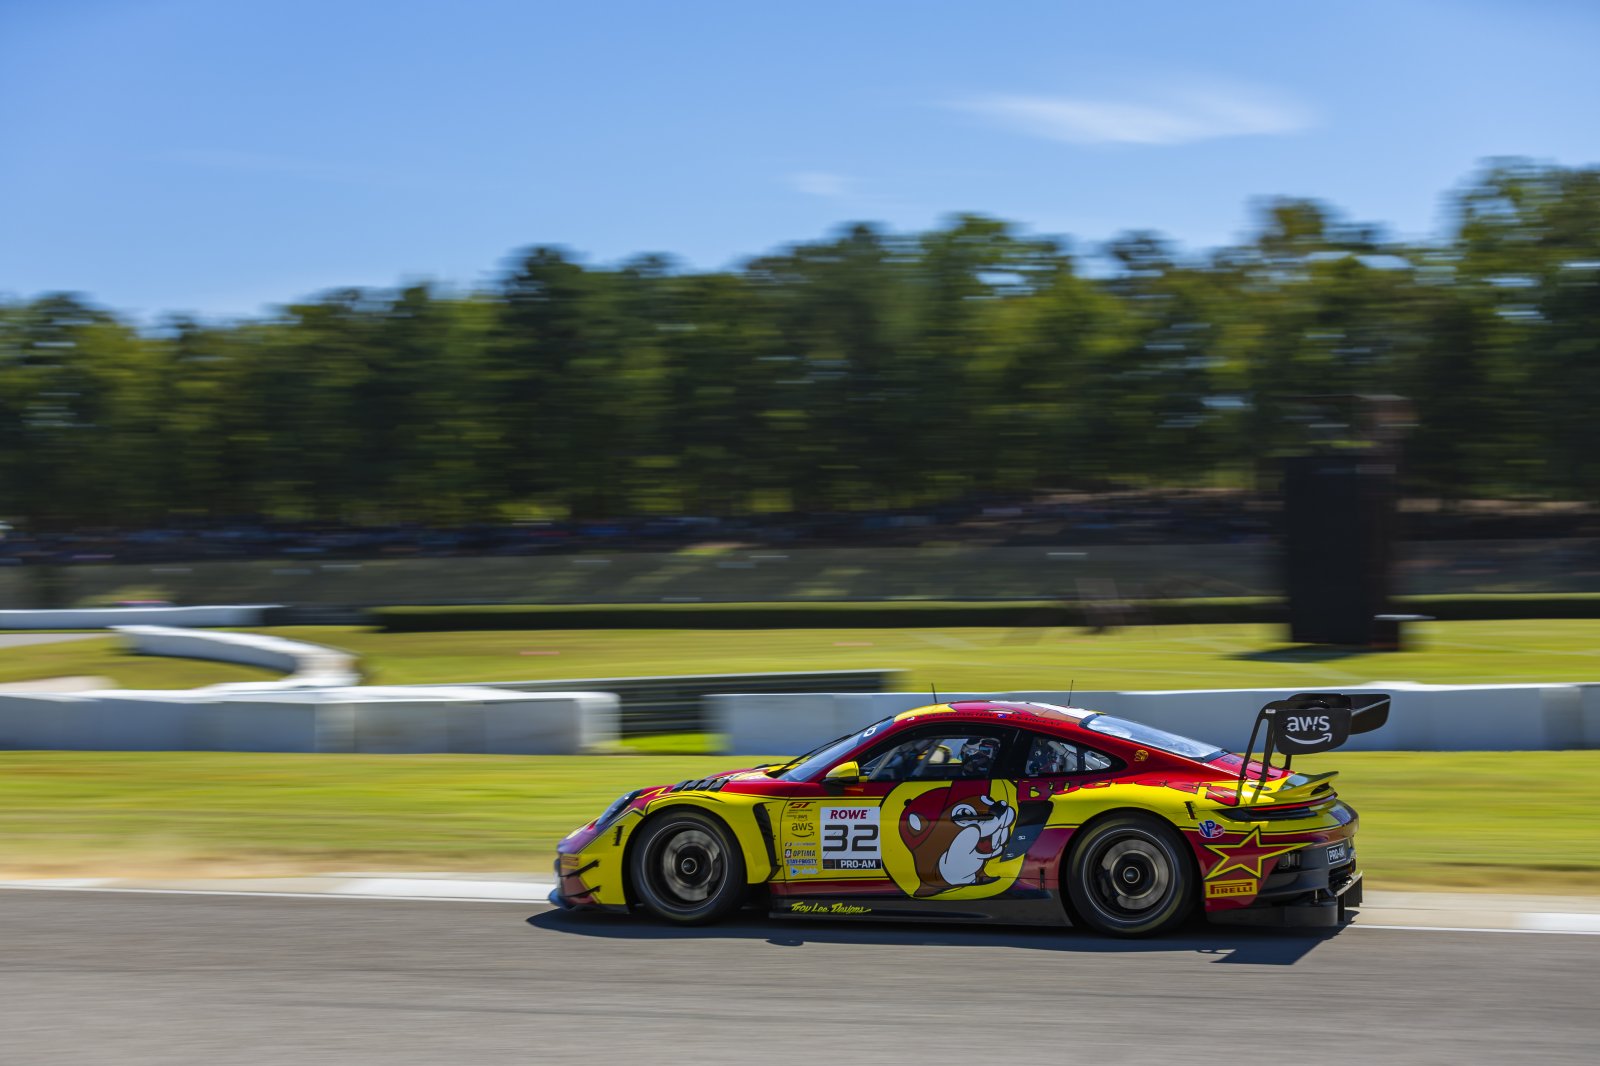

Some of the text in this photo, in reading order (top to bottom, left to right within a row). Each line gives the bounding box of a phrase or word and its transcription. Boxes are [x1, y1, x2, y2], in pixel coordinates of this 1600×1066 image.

[1287, 715, 1330, 732] aws
[830, 809, 868, 820] ROWE
[791, 822, 814, 831] aws
[1198, 820, 1216, 838] VP
[822, 824, 879, 852] 32
[793, 849, 816, 857] OPTIMA
[840, 860, 876, 869] PRO-AM
[1210, 882, 1253, 895] PIRELLI
[791, 901, 812, 913] Troy
[812, 902, 829, 913] Lee
